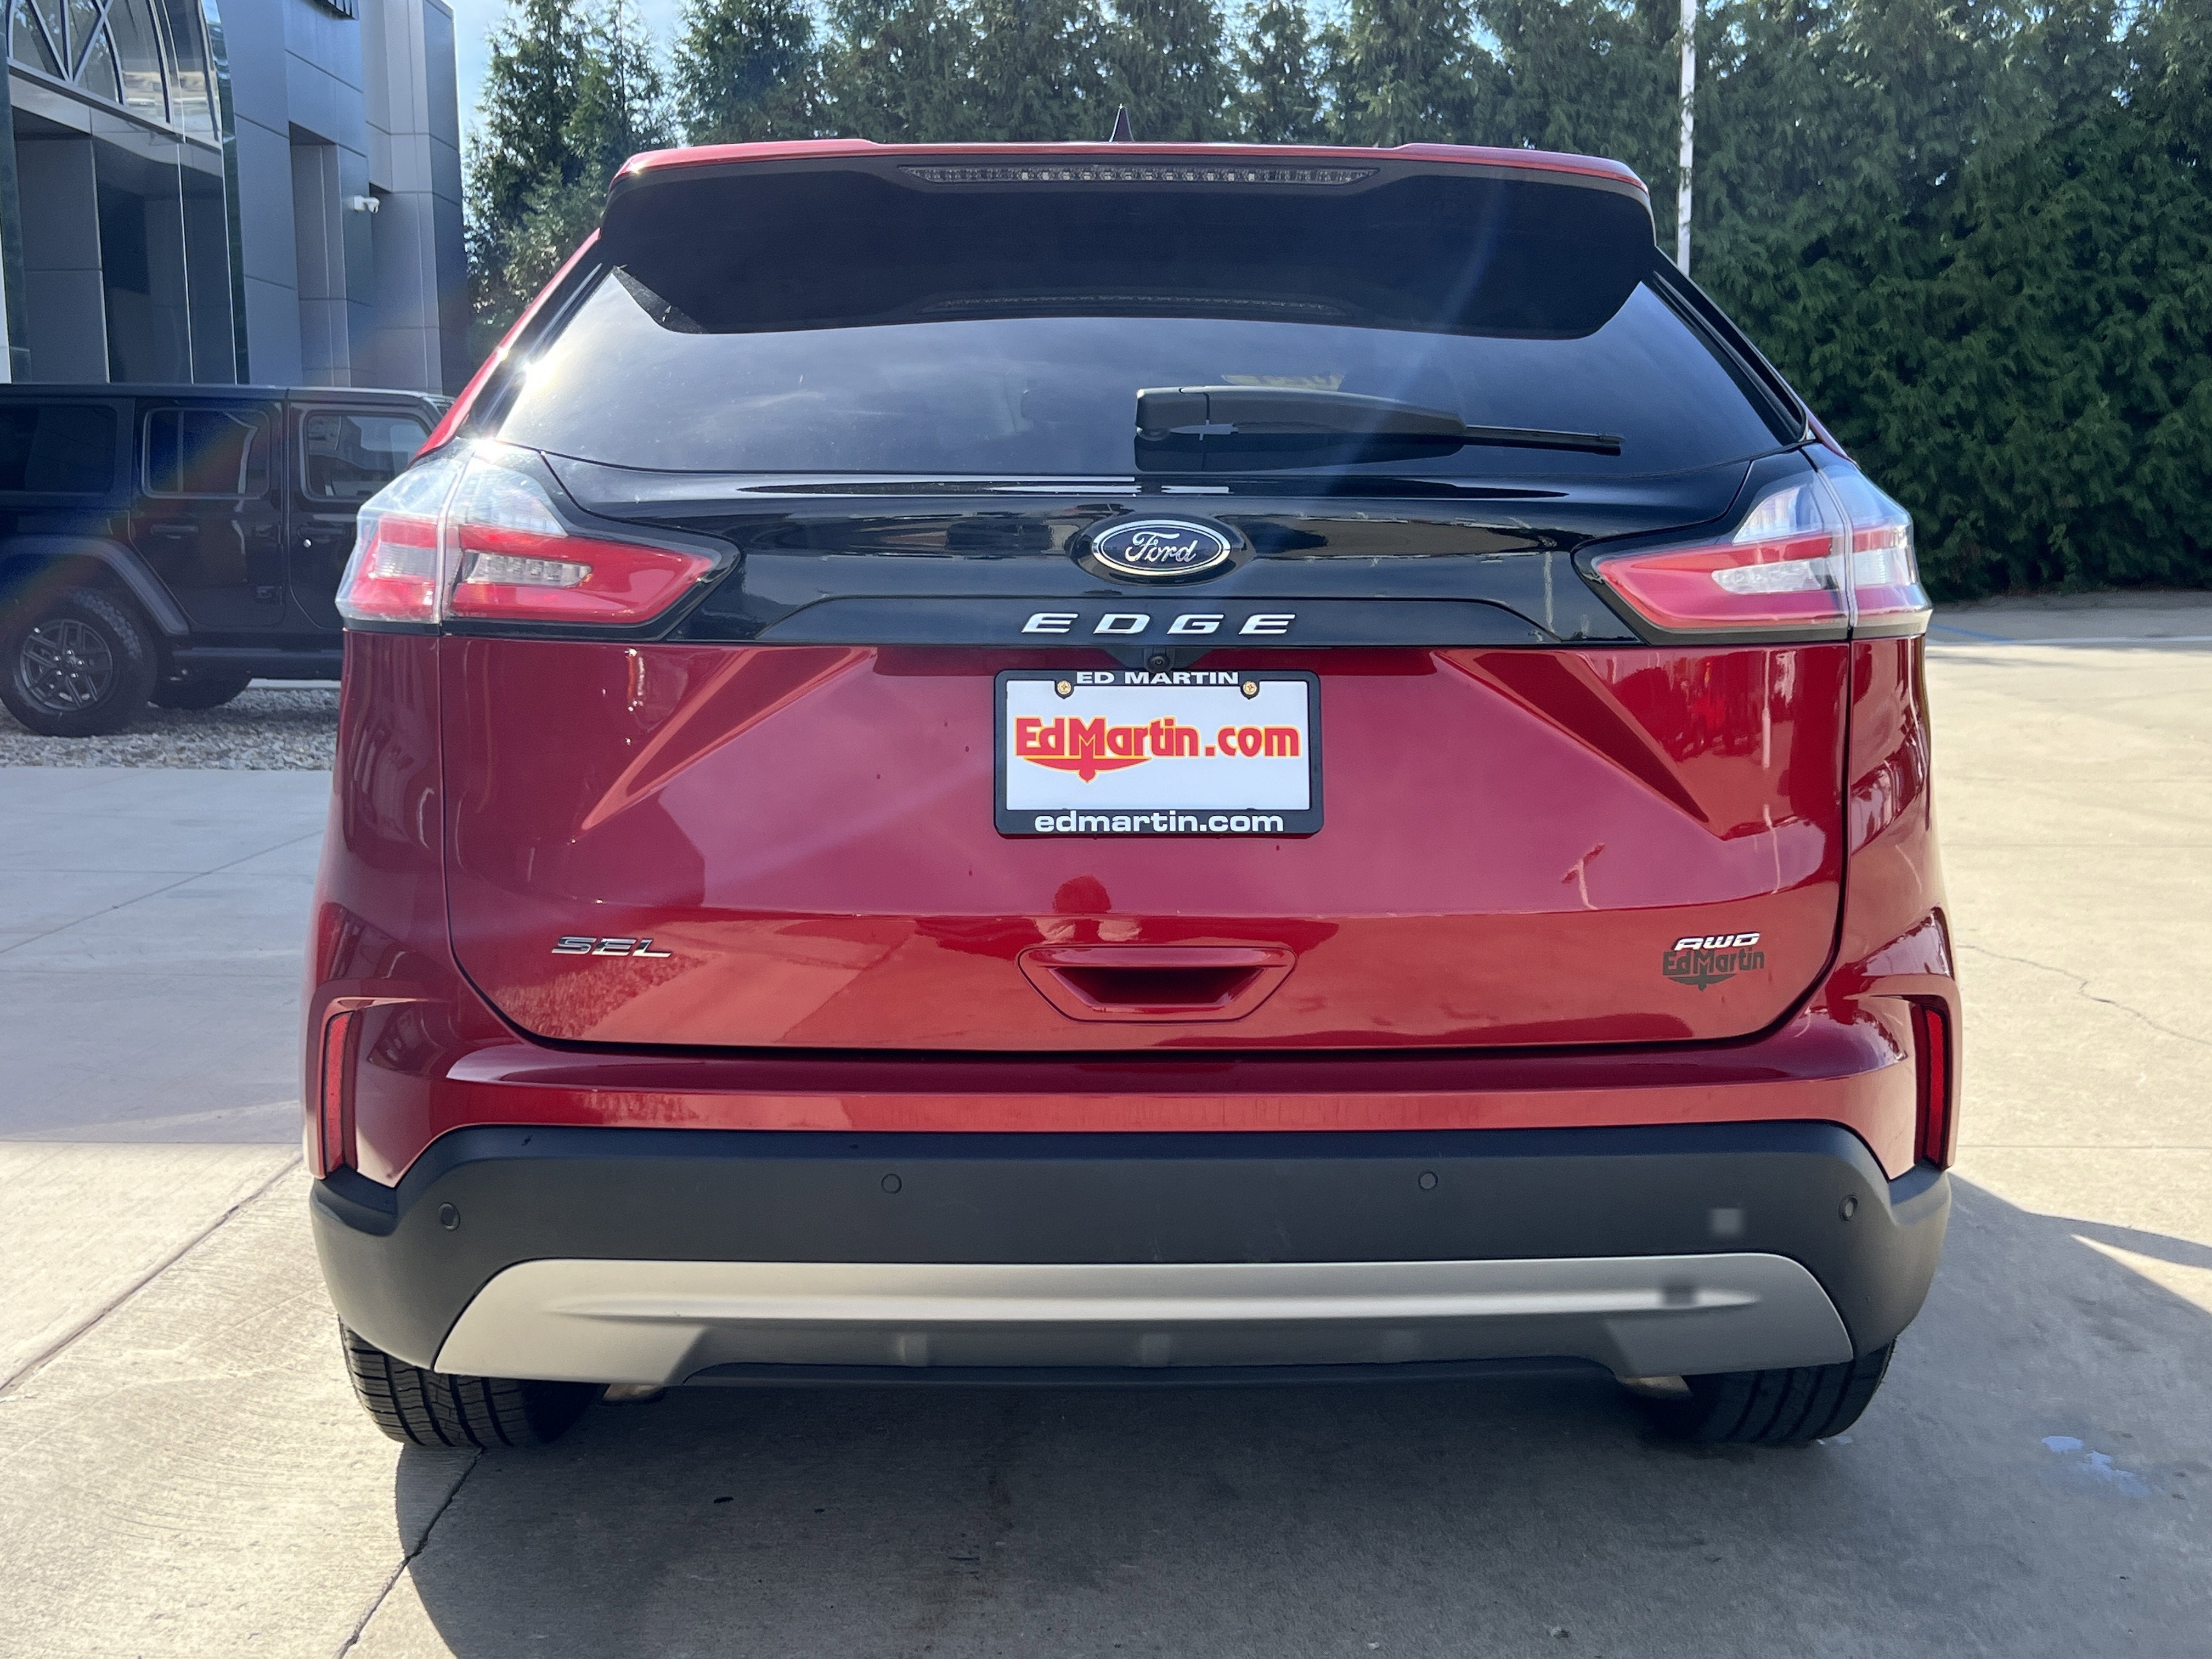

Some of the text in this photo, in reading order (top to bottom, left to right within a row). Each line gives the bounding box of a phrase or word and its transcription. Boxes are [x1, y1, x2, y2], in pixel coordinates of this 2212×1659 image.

[1125, 532, 1198, 562] Ford
[1022, 613, 1296, 635] EDGE
[1076, 672, 1239, 685] ED MARTIN
[1014, 716, 1302, 758] EdMartin.com
[1034, 810, 1284, 833] edmartin.com
[551, 936, 673, 958] SEL
[1673, 933, 1760, 951] AWD
[1663, 947, 1765, 975] EdMartin
